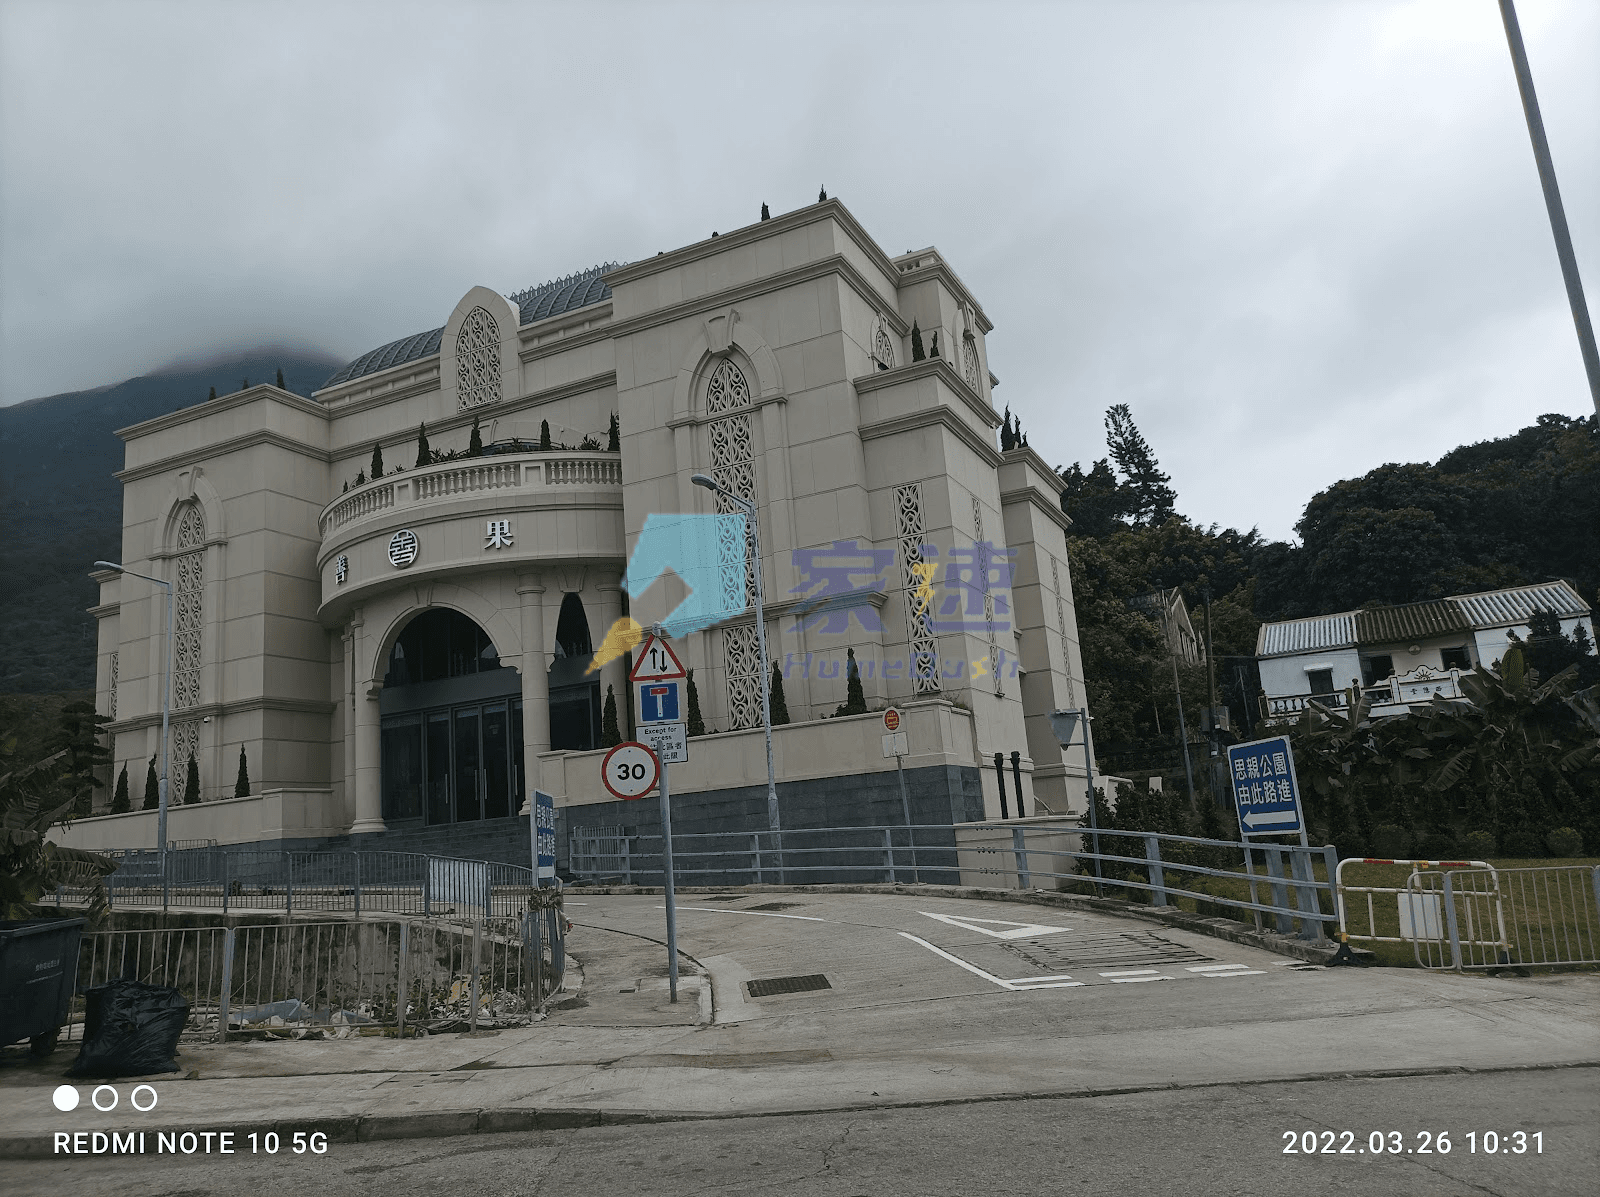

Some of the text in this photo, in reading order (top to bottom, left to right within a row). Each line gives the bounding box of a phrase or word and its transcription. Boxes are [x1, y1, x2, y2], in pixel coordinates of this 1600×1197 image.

[484, 519, 514, 550] 果
[644, 727, 666, 735] Except
[617, 763, 646, 781] 30
[1233, 751, 1288, 781] 思親公園
[1237, 778, 1293, 807] 由此路進
